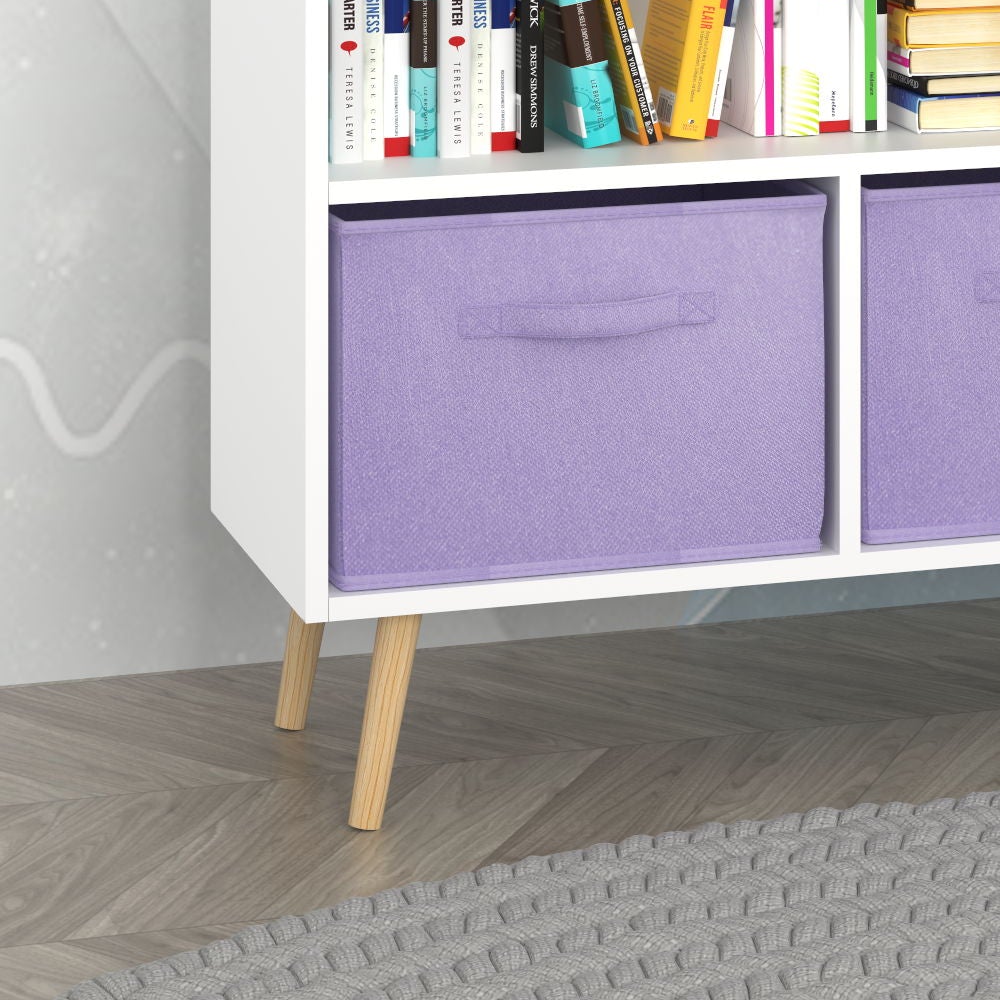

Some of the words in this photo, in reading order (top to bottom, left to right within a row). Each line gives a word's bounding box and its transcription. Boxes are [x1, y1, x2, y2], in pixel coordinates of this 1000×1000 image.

[614, 6, 629, 44] FOCUSING
[699, 5, 716, 30] FLAIR
[529, 45, 538, 76] DREW
[623, 44, 633, 56] ON
[626, 56, 639, 77] YOUR
[345, 67, 354, 110] TERESA
[369, 48, 377, 100] DENISE
[452, 62, 461, 104] TERESA
[529, 77, 538, 128] SIMMONS
[633, 78, 650, 118] CUSTOMER
[345, 116, 354, 150] LEWIS
[369, 109, 377, 144] COLE
[452, 110, 461, 145] LEWIS
